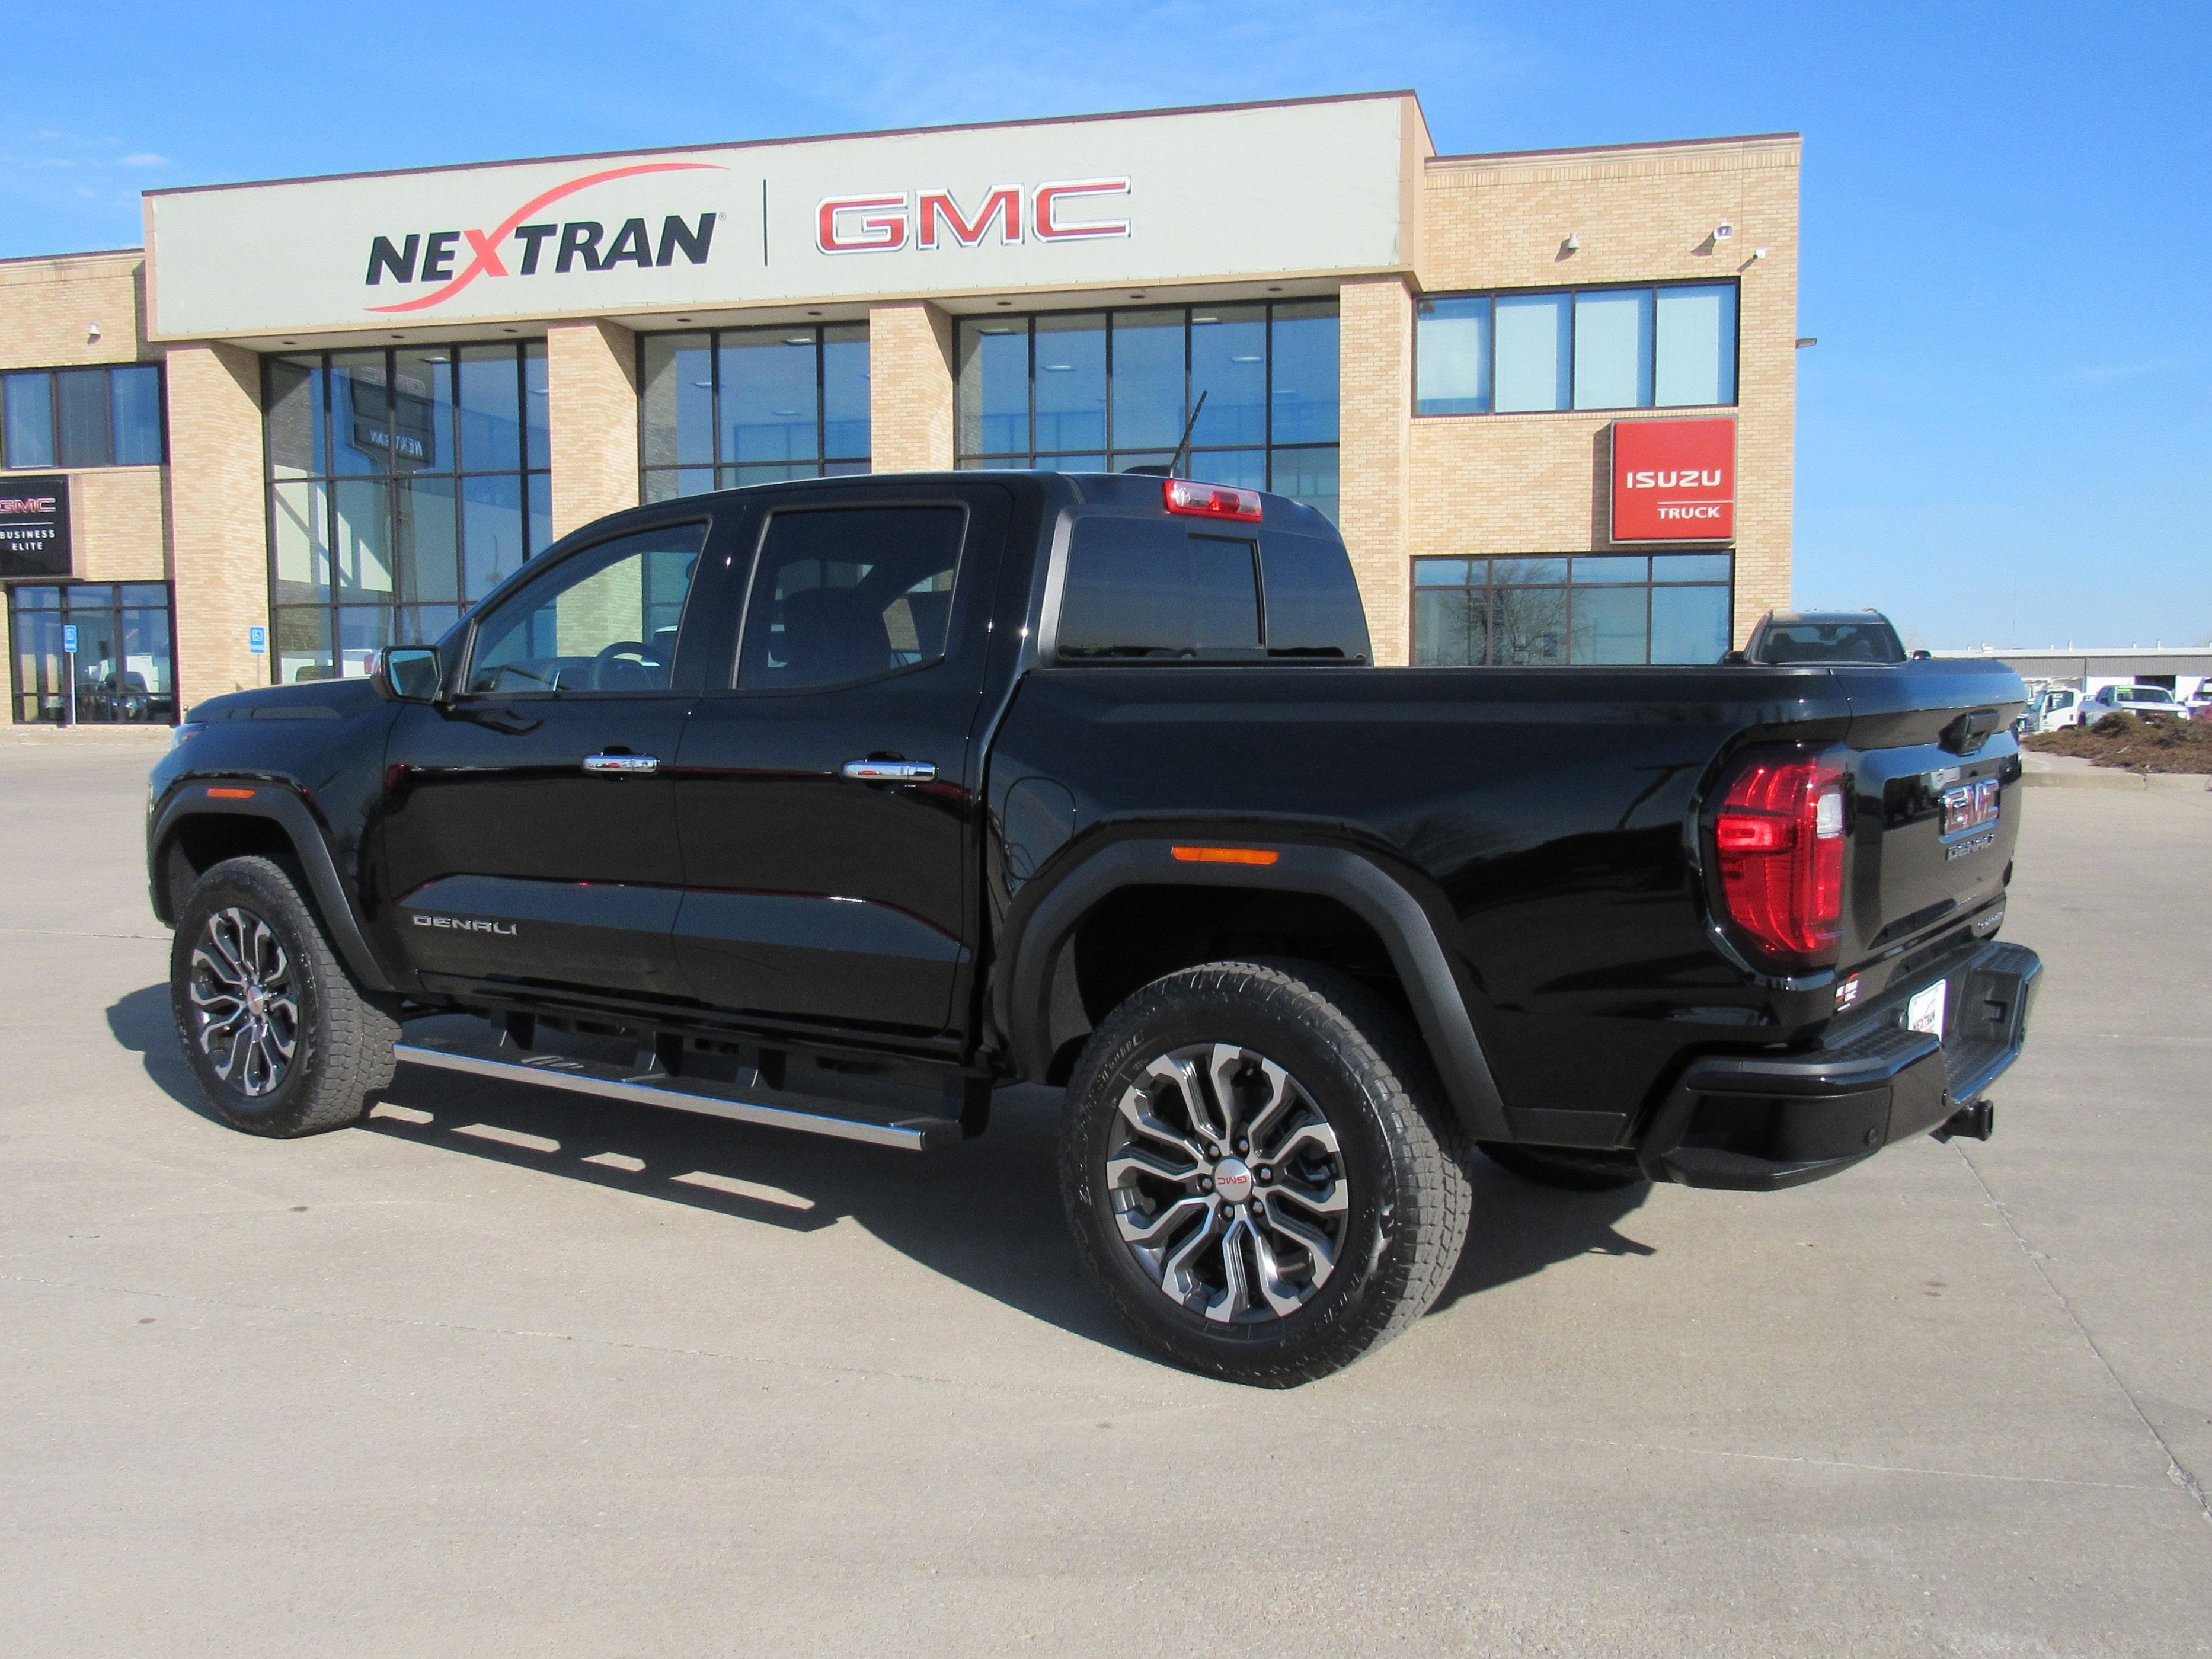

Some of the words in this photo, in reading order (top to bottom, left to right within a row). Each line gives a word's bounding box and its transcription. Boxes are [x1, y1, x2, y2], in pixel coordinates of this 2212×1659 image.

[815, 175, 1132, 256] GMC
[365, 212, 718, 286] NEXTRAN
[1626, 469, 1722, 489] ISUZU
[0, 497, 56, 514] GMC
[1657, 506, 1720, 519] TRUCK
[0, 529, 56, 540] BUSINESS
[12, 542, 44, 551] ELITE
[1944, 779, 1999, 835] GMC
[413, 914, 518, 935] DENALI
[1217, 1175, 1248, 1185] GMC
